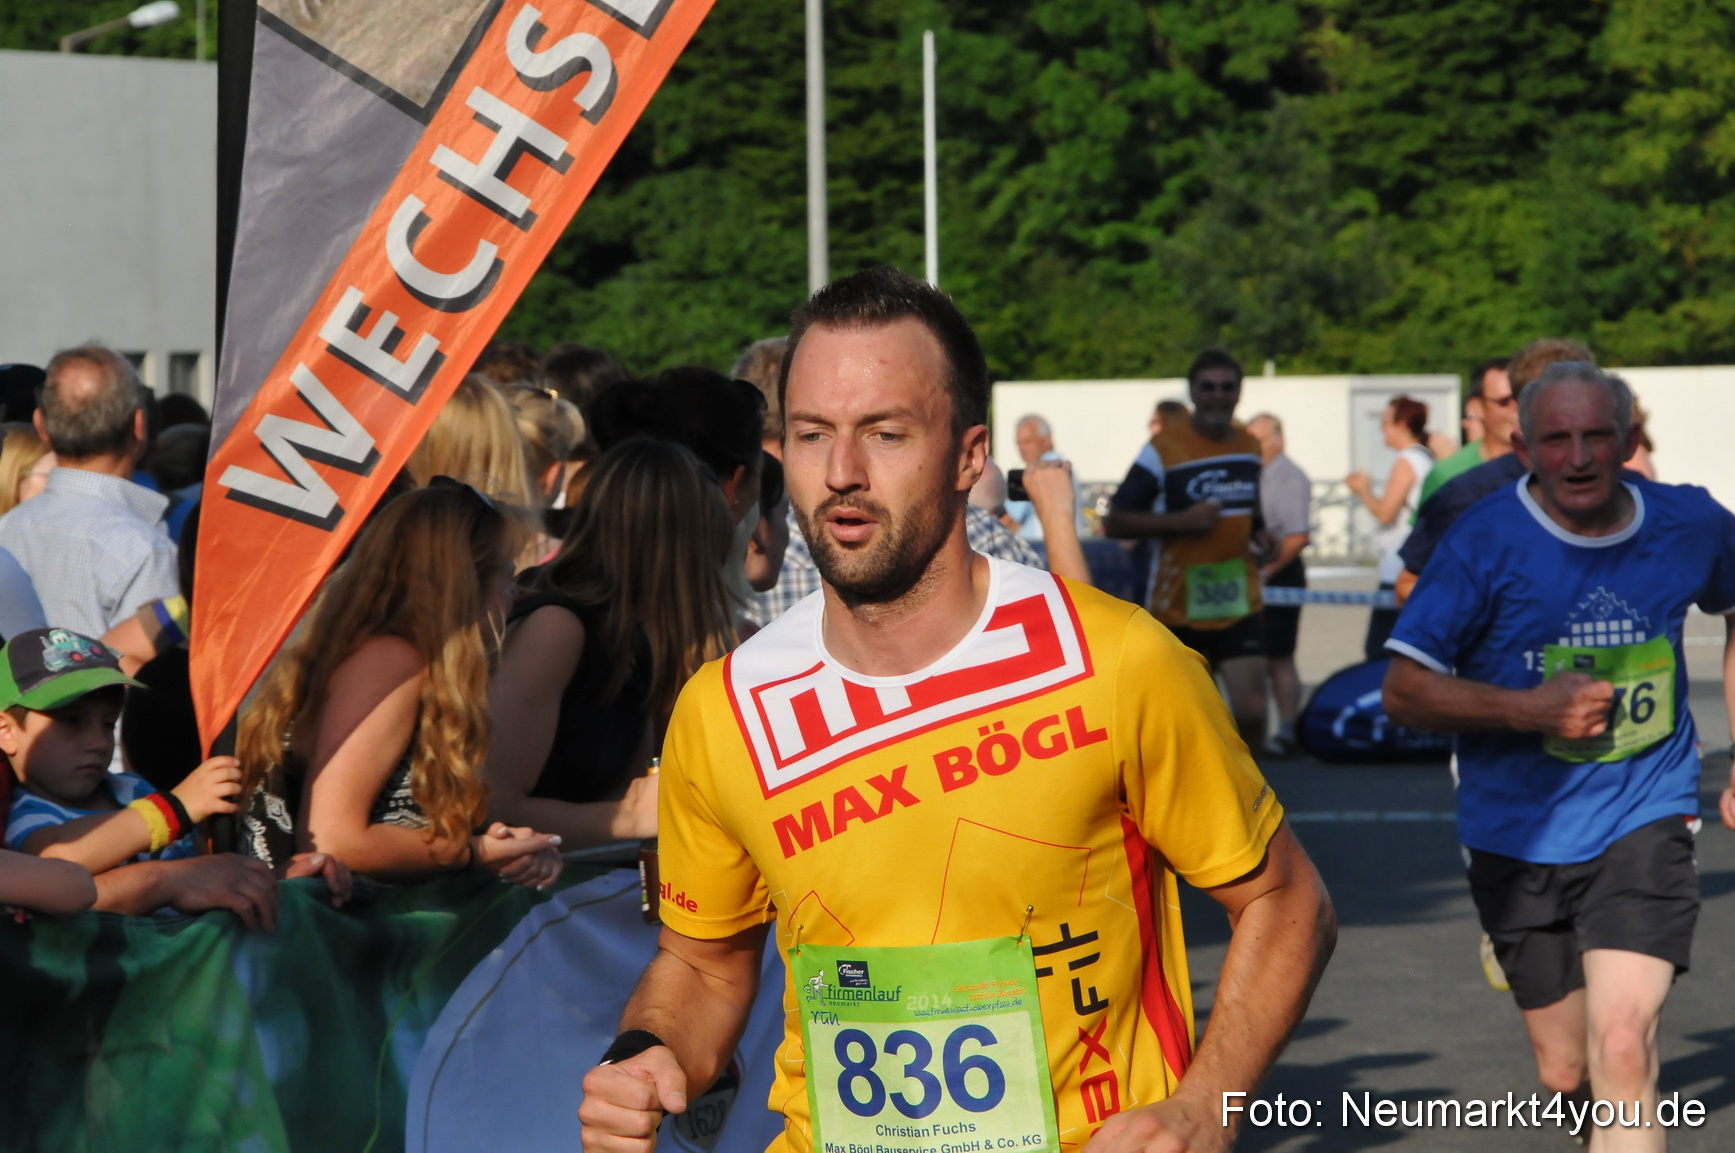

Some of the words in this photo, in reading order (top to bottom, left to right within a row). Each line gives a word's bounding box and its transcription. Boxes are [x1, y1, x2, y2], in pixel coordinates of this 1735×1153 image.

[772, 764, 921, 860] MAX
[933, 705, 1109, 793] BÖGL
[827, 984, 902, 1001] firmenlauf
[906, 993, 953, 1011] 2014
[834, 1024, 1006, 1119] 836
[875, 1124, 930, 1138] Christian
[933, 1121, 977, 1136] Fuchs
[825, 1143, 846, 1153] Max
[941, 1140, 980, 1153] GmbH
[984, 1138, 994, 1150] &
[997, 1136, 1019, 1149] Co.
[1022, 1134, 1042, 1146] KG
